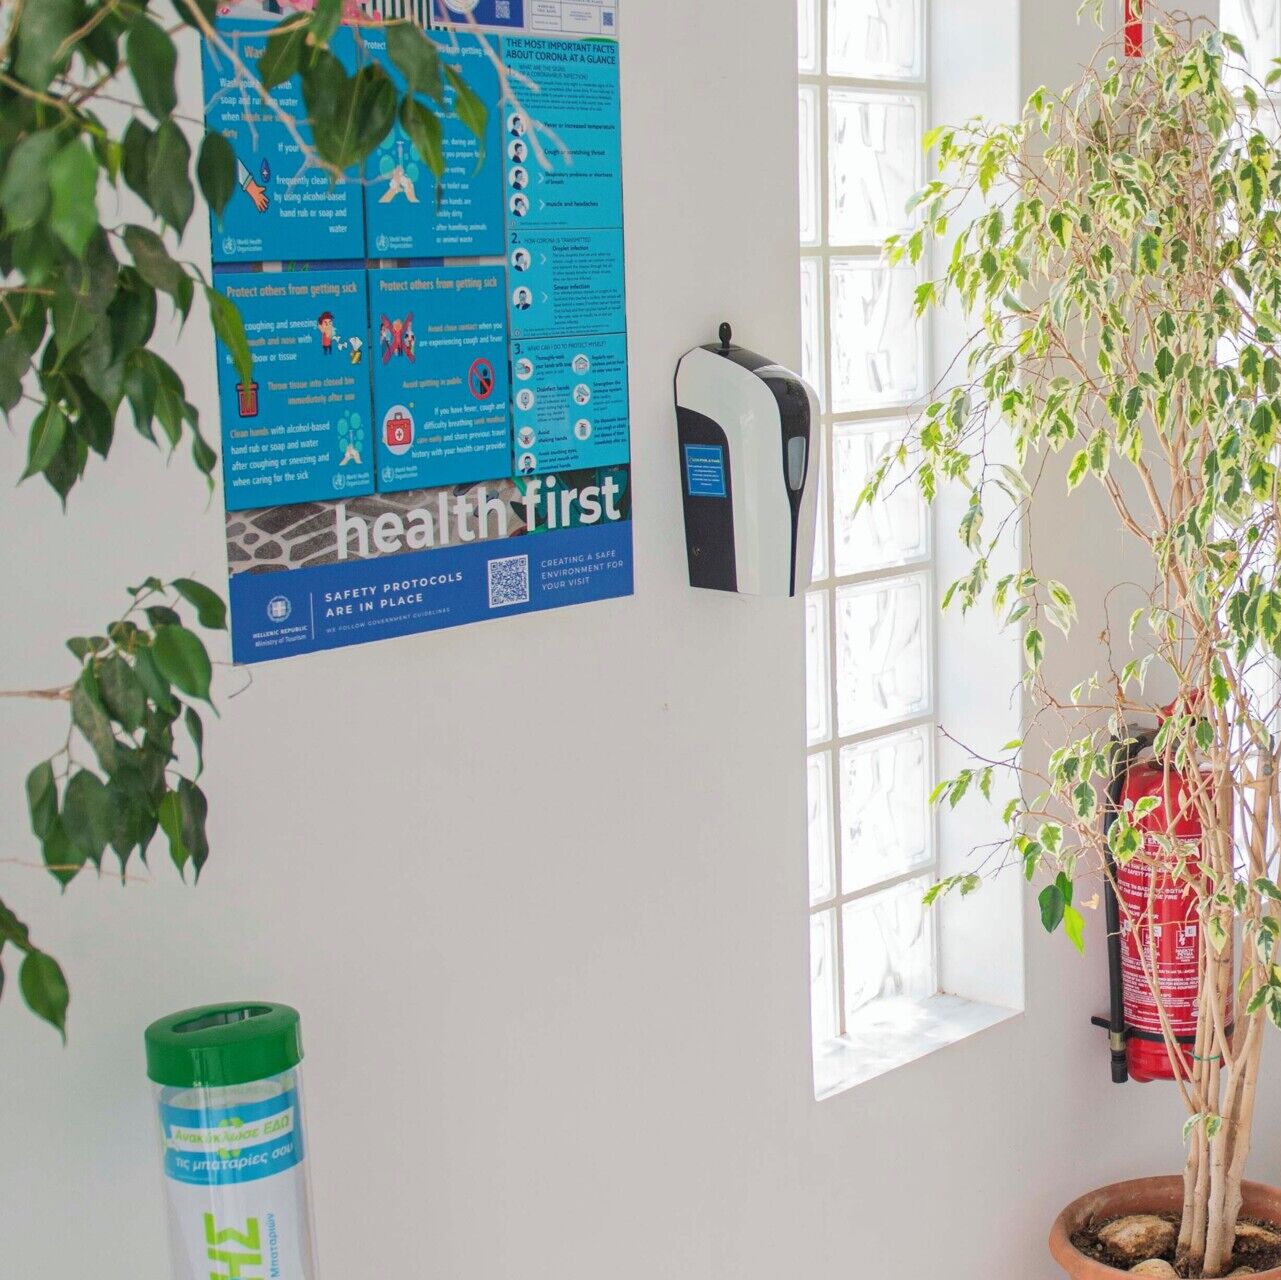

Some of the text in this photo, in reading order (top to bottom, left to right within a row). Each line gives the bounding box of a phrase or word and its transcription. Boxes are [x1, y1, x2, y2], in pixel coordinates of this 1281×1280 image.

[364, 40, 386, 50] Protect
[506, 38, 615, 53] THE MOST IMPORTANT FACTS
[506, 50, 615, 64] ABOUT CORONA AT GLANCE
[221, 97, 237, 106] soap
[222, 112, 240, 120] when
[276, 175, 309, 186] frequently
[274, 191, 346, 203] by using alcohol-based
[280, 209, 296, 218] hand
[297, 209, 308, 218] rub
[318, 210, 333, 219] soap
[335, 208, 346, 217] and
[511, 232, 521, 244] 2.
[227, 282, 357, 297] Protect others from getting sick
[380, 277, 497, 291] Protect others from getting sick
[245, 319, 317, 332] coughing and sneezing
[298, 335, 312, 344] with
[429, 339, 462, 348] experiencing
[463, 337, 478, 346] cough
[514, 344, 524, 355] 3.
[278, 352, 297, 361] tissue
[440, 408, 449, 416] you
[480, 404, 494, 412] cough
[271, 421, 330, 434] with alcohol-based
[424, 419, 473, 430] difficulty breathing
[231, 446, 247, 455] hand
[249, 444, 260, 453] rub
[270, 442, 285, 452] soap
[287, 440, 299, 449] and
[301, 440, 318, 448] water
[486, 442, 506, 451] provider
[232, 461, 248, 471] after
[249, 459, 279, 471] coughing
[289, 455, 316, 466] sneezing
[318, 453, 329, 462] and
[233, 470, 309, 486] when caring for the sick
[335, 476, 621, 559] health first
[541, 555, 584, 568] CREATING
[596, 550, 616, 560] SAFE
[542, 560, 624, 579] ENVIRONMENT FOR
[325, 572, 463, 602] SAFETY PROTOCOLS
[542, 577, 590, 591] YOUR VISIT
[326, 593, 424, 618] ARE IN PLACE
[338, 623, 365, 631] FOLLOW
[368, 614, 410, 628] GOVERNMENT
[413, 608, 450, 618] GUIDELINES
[253, 626, 308, 639] HELLENIC REPUBLIC
[255, 639, 278, 648] Ministry
[286, 634, 306, 643] Tourism
[264, 1116, 289, 1134] ΕΔΩ
[175, 1143, 294, 1172] τις μπαταρίες σου
